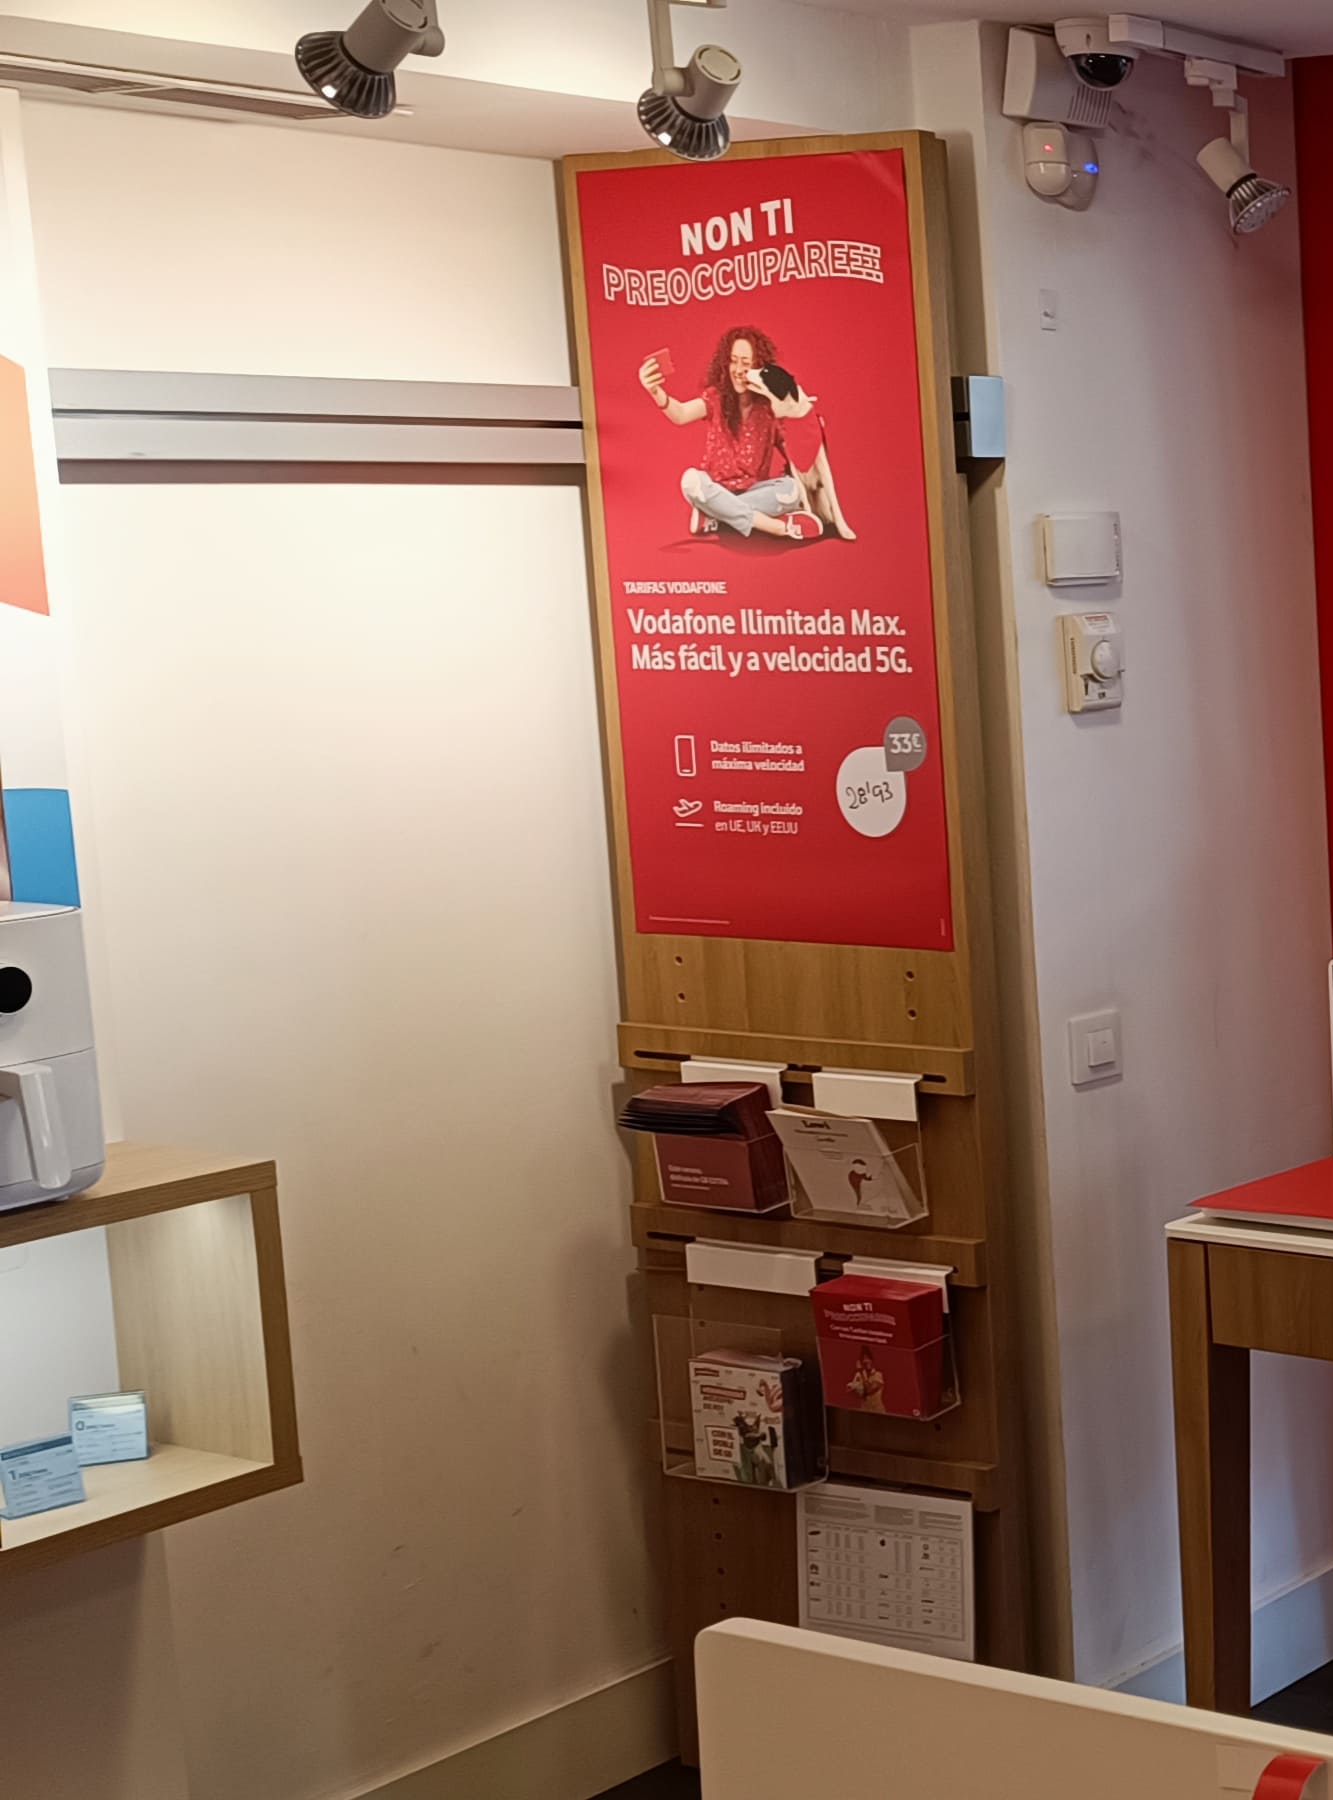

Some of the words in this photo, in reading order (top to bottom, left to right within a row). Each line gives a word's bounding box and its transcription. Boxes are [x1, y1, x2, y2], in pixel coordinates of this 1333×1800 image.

[680, 207, 754, 256] NON
[759, 198, 794, 237] TI
[623, 581, 667, 594] TARIFAS
[667, 581, 728, 594] VODAFONE
[626, 608, 736, 634] Vodafone
[740, 609, 845, 635] Ilimitada
[851, 608, 907, 636] Max.
[631, 642, 676, 671] Más
[678, 642, 727, 671] fácil
[728, 651, 743, 677] y
[746, 651, 760, 671] a
[762, 645, 872, 673] velocidad
[875, 646, 913, 673] 5G.
[710, 740, 741, 753] Datos
[741, 741, 794, 754] ilimitados
[795, 744, 803, 754] a
[888, 733, 922, 753] 33€
[711, 757, 753, 770] máxima
[754, 759, 805, 772] velocidad
[713, 800, 760, 816] Roaming
[760, 801, 803, 815] incluido
[715, 821, 728, 832] en
[746, 820, 762, 833] UK
[762, 823, 770, 836] y
[770, 821, 798, 834] EEUU
